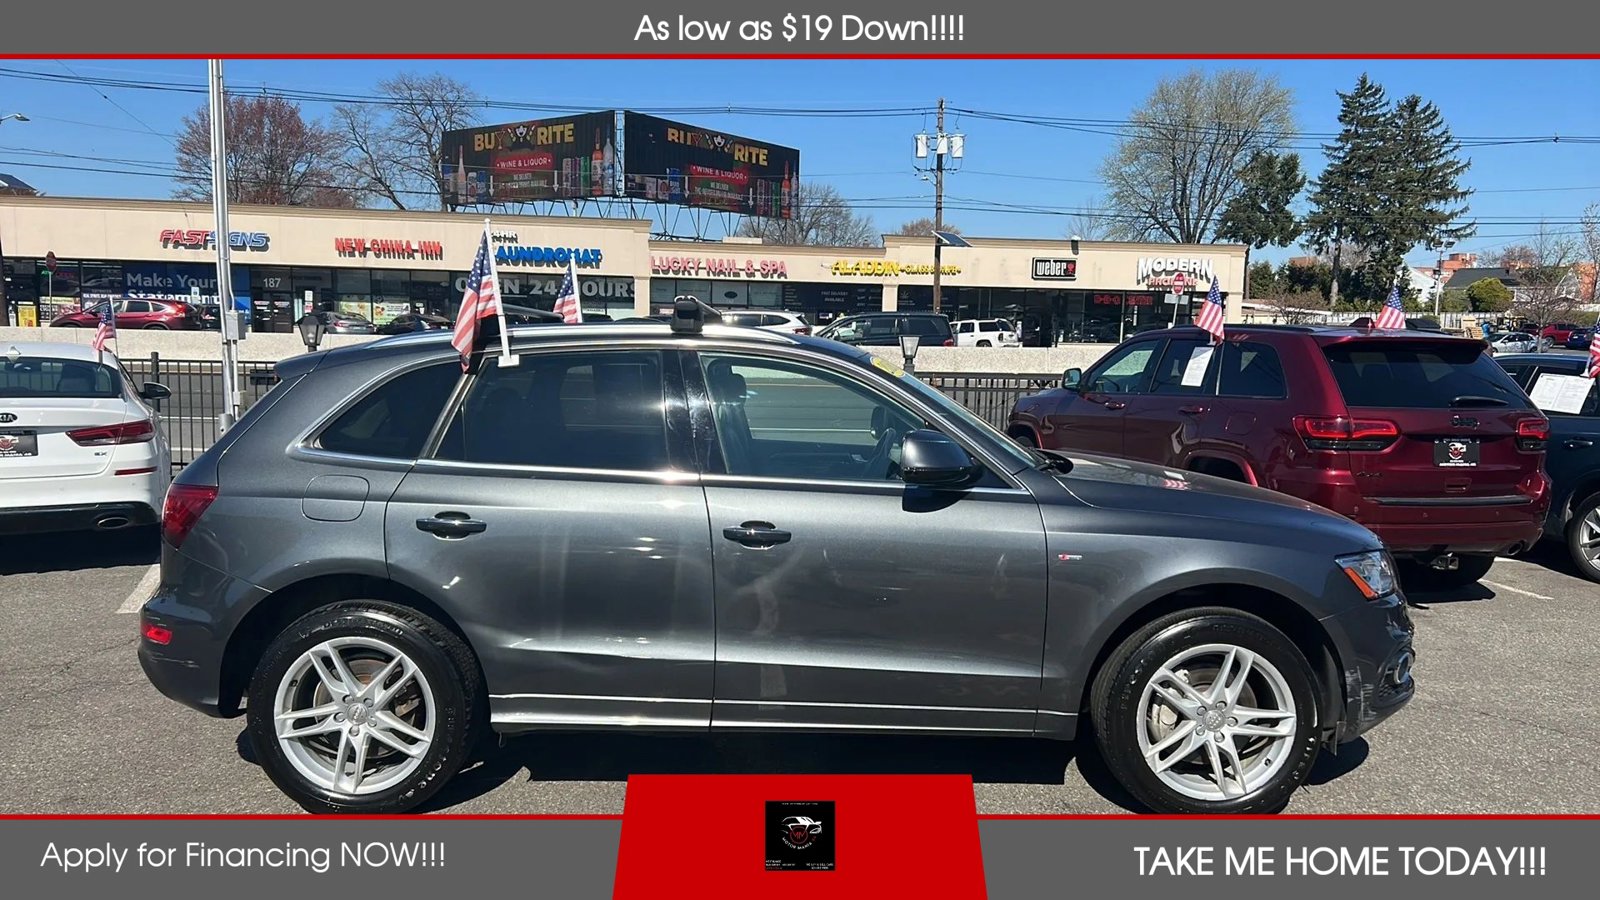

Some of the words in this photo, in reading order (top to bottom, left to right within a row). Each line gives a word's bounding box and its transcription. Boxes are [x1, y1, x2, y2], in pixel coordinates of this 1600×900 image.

[537, 123, 574, 146] RITE
[501, 159, 517, 168] WINE
[518, 159, 523, 167] &
[523, 157, 548, 167] LIQUOR
[734, 144, 768, 166] RITE
[697, 165, 713, 175] WINE
[720, 170, 744, 180] LIQUOR
[160, 229, 268, 249] FASTSGNS
[335, 238, 366, 255] NEW
[370, 239, 414, 256] CHINA
[418, 240, 442, 257] INN
[495, 245, 601, 265] AUNDROMAT
[650, 256, 700, 273] LUCKY
[706, 258, 740, 275] NAIL
[745, 259, 755, 275] &
[760, 260, 787, 277] SPA
[832, 260, 899, 276] ALADDIN
[905, 264, 929, 275] GLASS
[941, 265, 957, 275] APE
[1036, 260, 1067, 276] weber
[1138, 257, 1213, 280] MODERN
[126, 273, 173, 288] Make
[176, 274, 217, 289] Your
[263, 277, 281, 288] 187
[455, 277, 521, 294] ON
[529, 280, 558, 295] 24
[580, 281, 634, 298] OUR
